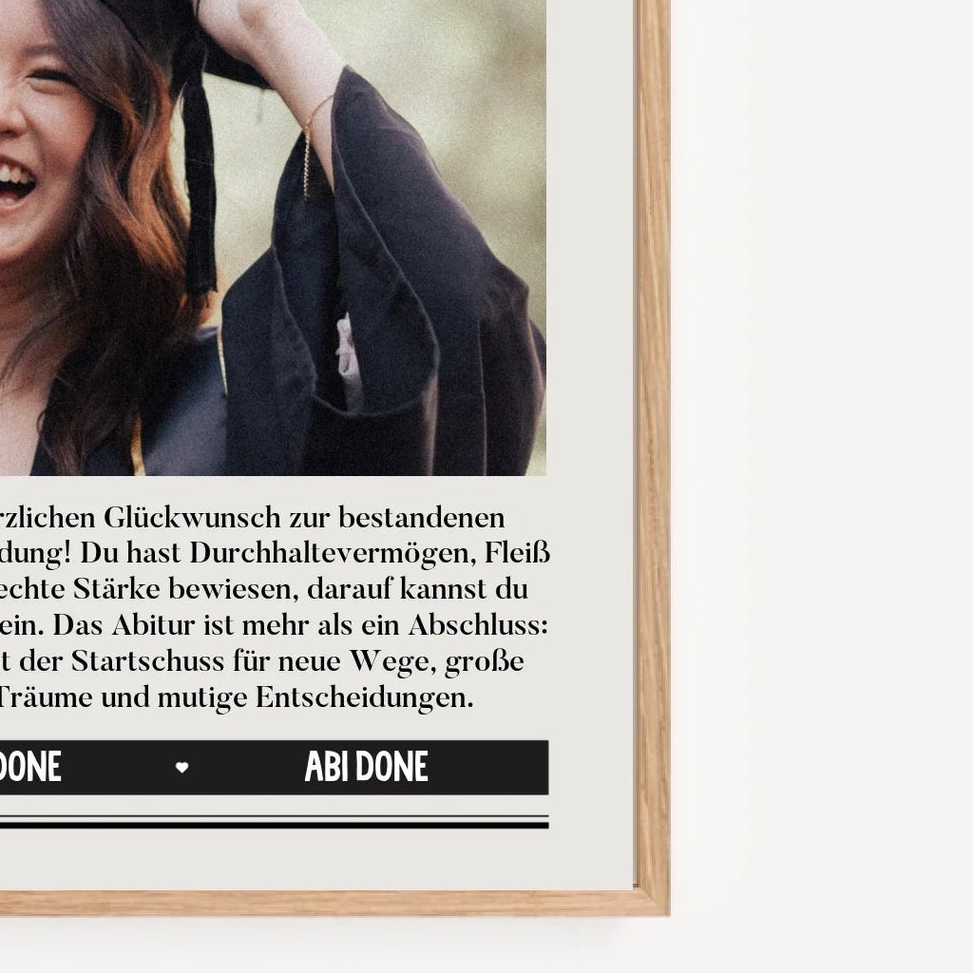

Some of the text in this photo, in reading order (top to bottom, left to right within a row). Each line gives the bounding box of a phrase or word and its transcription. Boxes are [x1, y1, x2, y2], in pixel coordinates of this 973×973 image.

[104, 504, 281, 528] Glückwunsch
[289, 512, 331, 528] zur
[338, 504, 505, 528] bestandenen
[81, 541, 119, 564] Du
[126, 539, 181, 564] hast
[190, 539, 477, 571] Durchhaltevermögen,
[485, 539, 551, 564] Fleiß
[73, 575, 161, 600] Stärke
[168, 575, 299, 603] bewiesen,
[307, 575, 395, 600] darauf
[400, 575, 487, 600] kannst
[495, 575, 528, 600] du
[53, 613, 103, 636] Das
[111, 611, 196, 636] Abitur
[204, 614, 235, 636] ist
[242, 611, 310, 636] mehr
[318, 611, 353, 636] als
[361, 614, 400, 636] ein
[408, 611, 548, 636] Abschluss:
[19, 647, 64, 672] der
[71, 648, 225, 672] Startschuss
[233, 647, 271, 672] für
[278, 655, 341, 672] neue
[349, 649, 437, 680] Wege,
[444, 647, 525, 680] große
[101, 683, 150, 708] und
[157, 686, 248, 716] mutige
[256, 684, 474, 716] Entscheidungen.
[304, 750, 429, 782] ABI DONE
